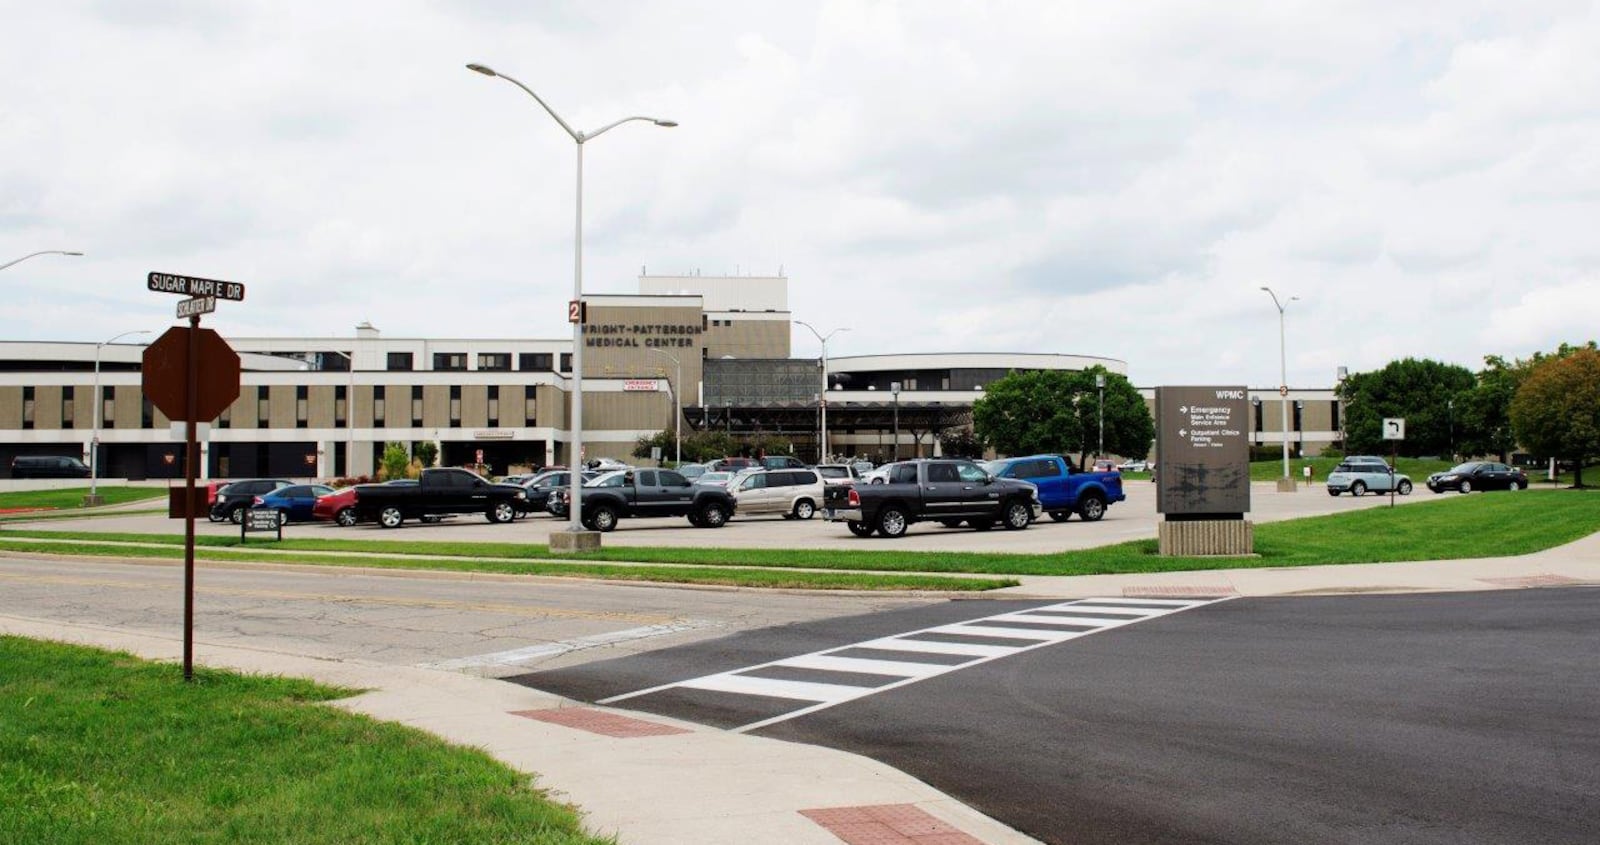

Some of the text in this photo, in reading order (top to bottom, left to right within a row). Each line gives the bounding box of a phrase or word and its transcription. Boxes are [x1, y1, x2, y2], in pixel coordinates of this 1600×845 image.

[151, 274, 186, 292] SUGAR
[226, 284, 241, 299] DR
[570, 303, 580, 320] 2
[586, 337, 693, 347] MEDICAL CENTER
[1216, 390, 1244, 399] WPMC
[1280, 387, 1287, 396] 2
[1190, 406, 1231, 414] Emergency
